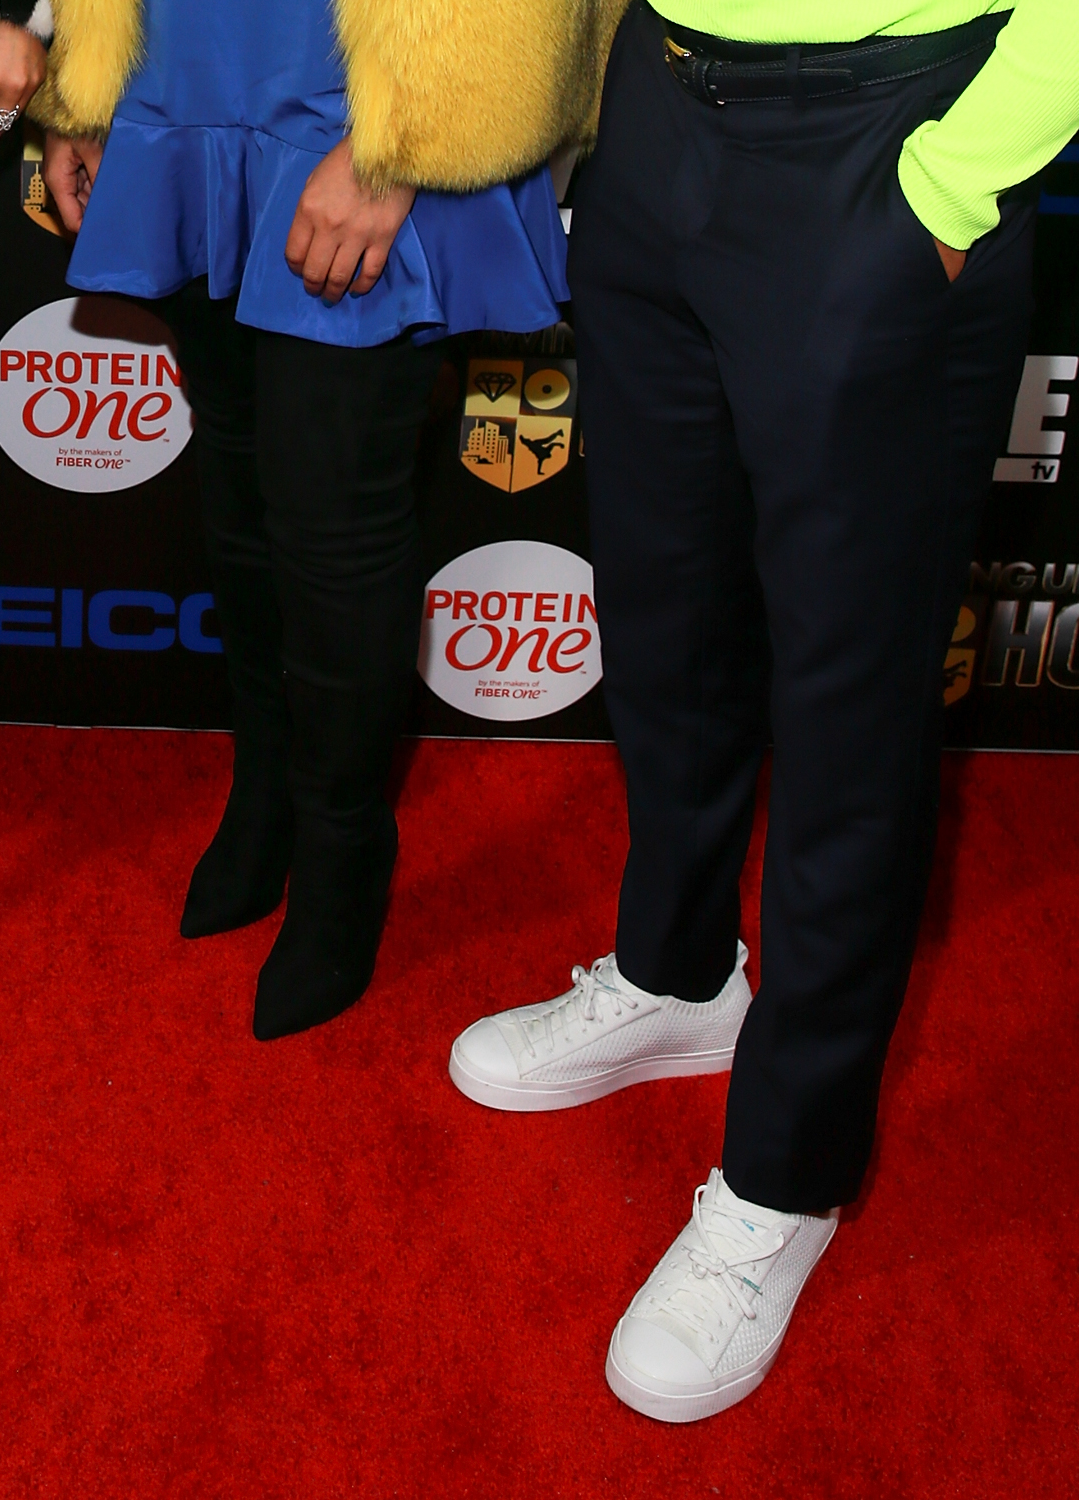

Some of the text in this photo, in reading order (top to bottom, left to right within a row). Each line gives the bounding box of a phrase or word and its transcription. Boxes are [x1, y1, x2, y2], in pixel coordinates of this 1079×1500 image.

[0, 350, 182, 387] PROTEIN
[1007, 355, 1079, 454] E
[58, 448, 123, 456] by the makers of
[56, 457, 92, 468] FIBER
[1031, 461, 1055, 480] tv
[426, 590, 599, 623] PROTEIN
[478, 679, 488, 687] by
[475, 688, 510, 698] FIBER
